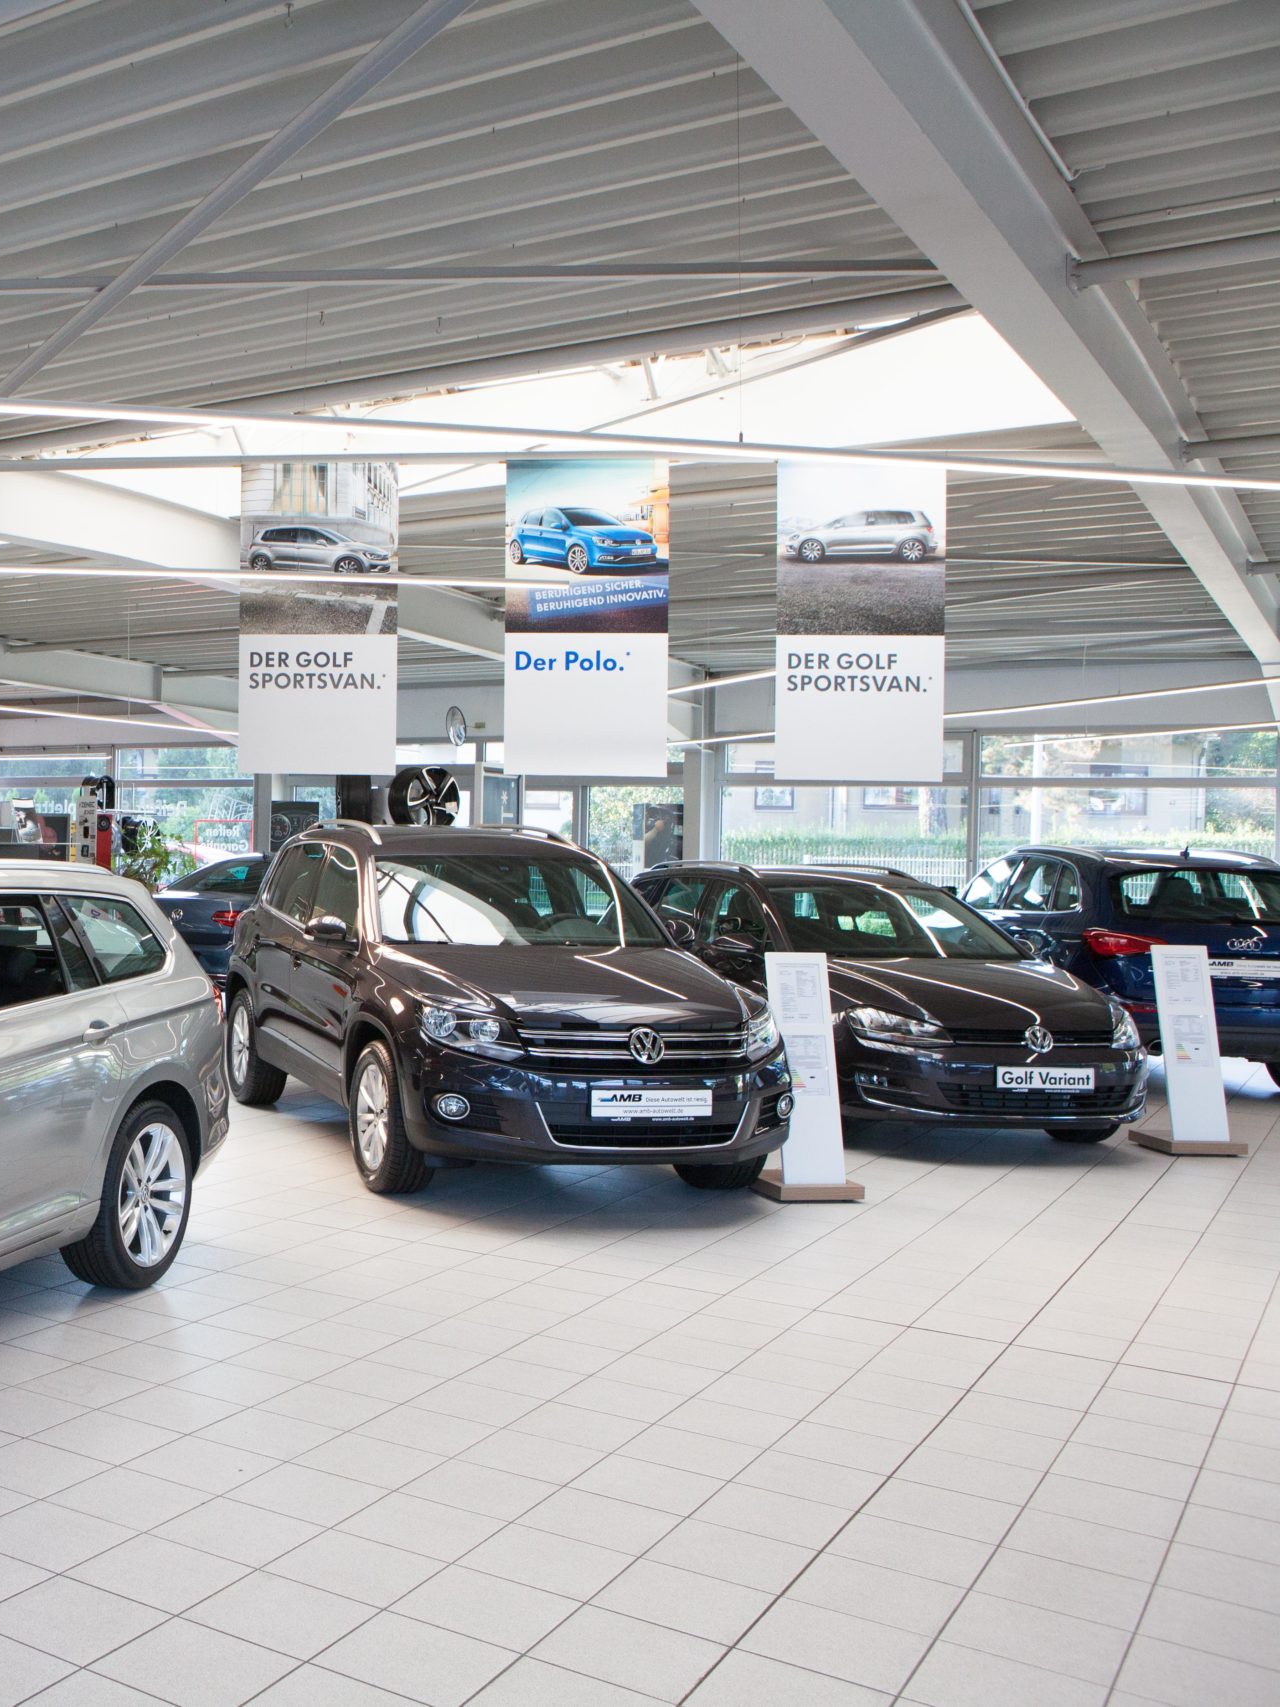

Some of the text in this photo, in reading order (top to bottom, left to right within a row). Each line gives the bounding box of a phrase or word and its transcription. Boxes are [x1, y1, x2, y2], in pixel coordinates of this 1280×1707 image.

[535, 579, 645, 600] BERUHIGEND SICHER.
[536, 588, 667, 612] BERUHIGEND INNOVATIV.
[249, 651, 353, 668] DER GOLF
[514, 650, 625, 671] Der Polo.
[787, 652, 898, 670] DER GOLF
[1001, 1070, 1091, 1086] Golf Variant
[609, 1093, 643, 1103] AMB
